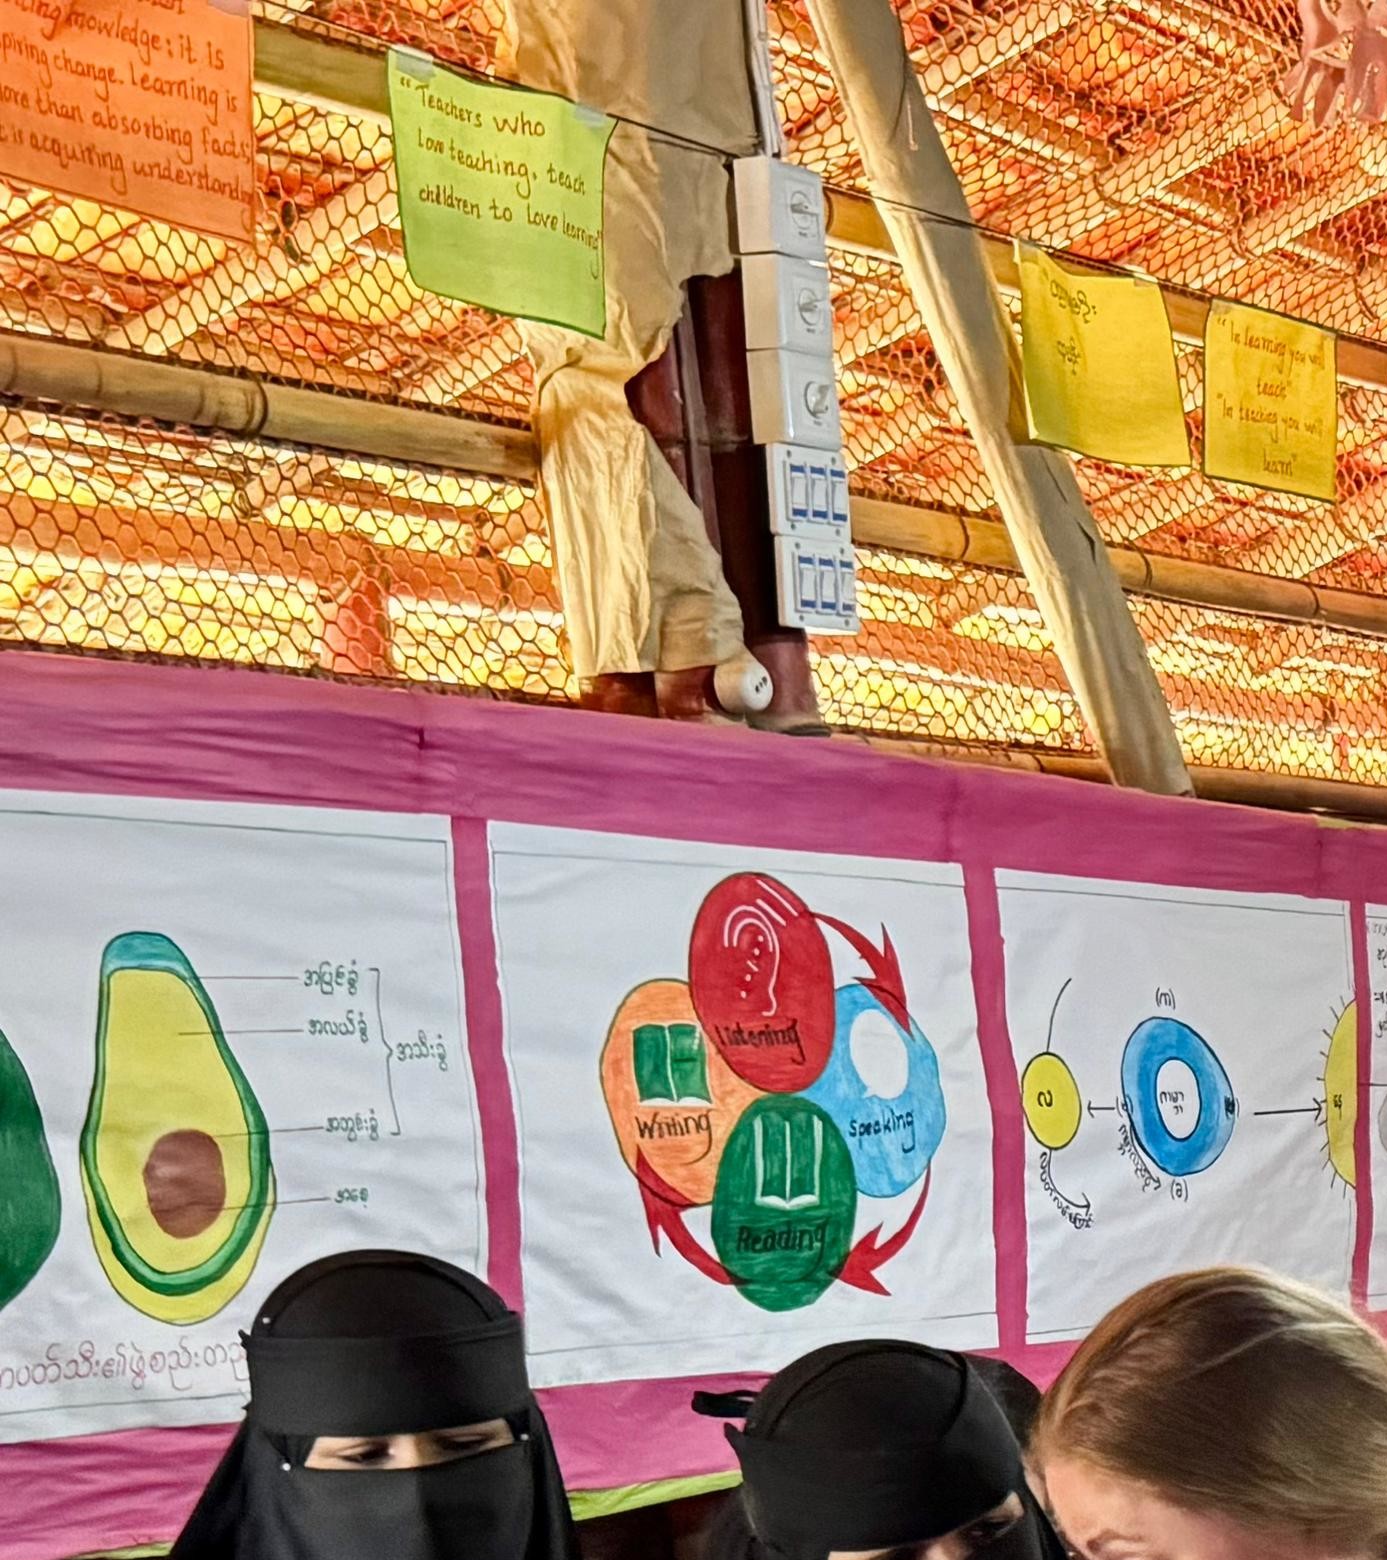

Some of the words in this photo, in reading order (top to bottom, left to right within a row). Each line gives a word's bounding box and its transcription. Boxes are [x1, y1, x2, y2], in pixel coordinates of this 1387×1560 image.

[0, 31, 52, 90] piring
[225, 89, 238, 114] is
[178, 34, 197, 65] it
[206, 40, 225, 71] is
[35, 87, 84, 123] than
[91, 105, 194, 166] absorbing
[418, 183, 482, 220] children
[489, 198, 514, 223] to
[546, 162, 587, 197] teach
[1243, 326, 1288, 374] learning
[1288, 347, 1307, 378] you
[1237, 403, 1279, 445] teaching
[1281, 413, 1301, 441] you
[714, 1016, 806, 1066] Listening
[634, 1107, 715, 1165] Writing
[737, 1215, 830, 1284] Reading
